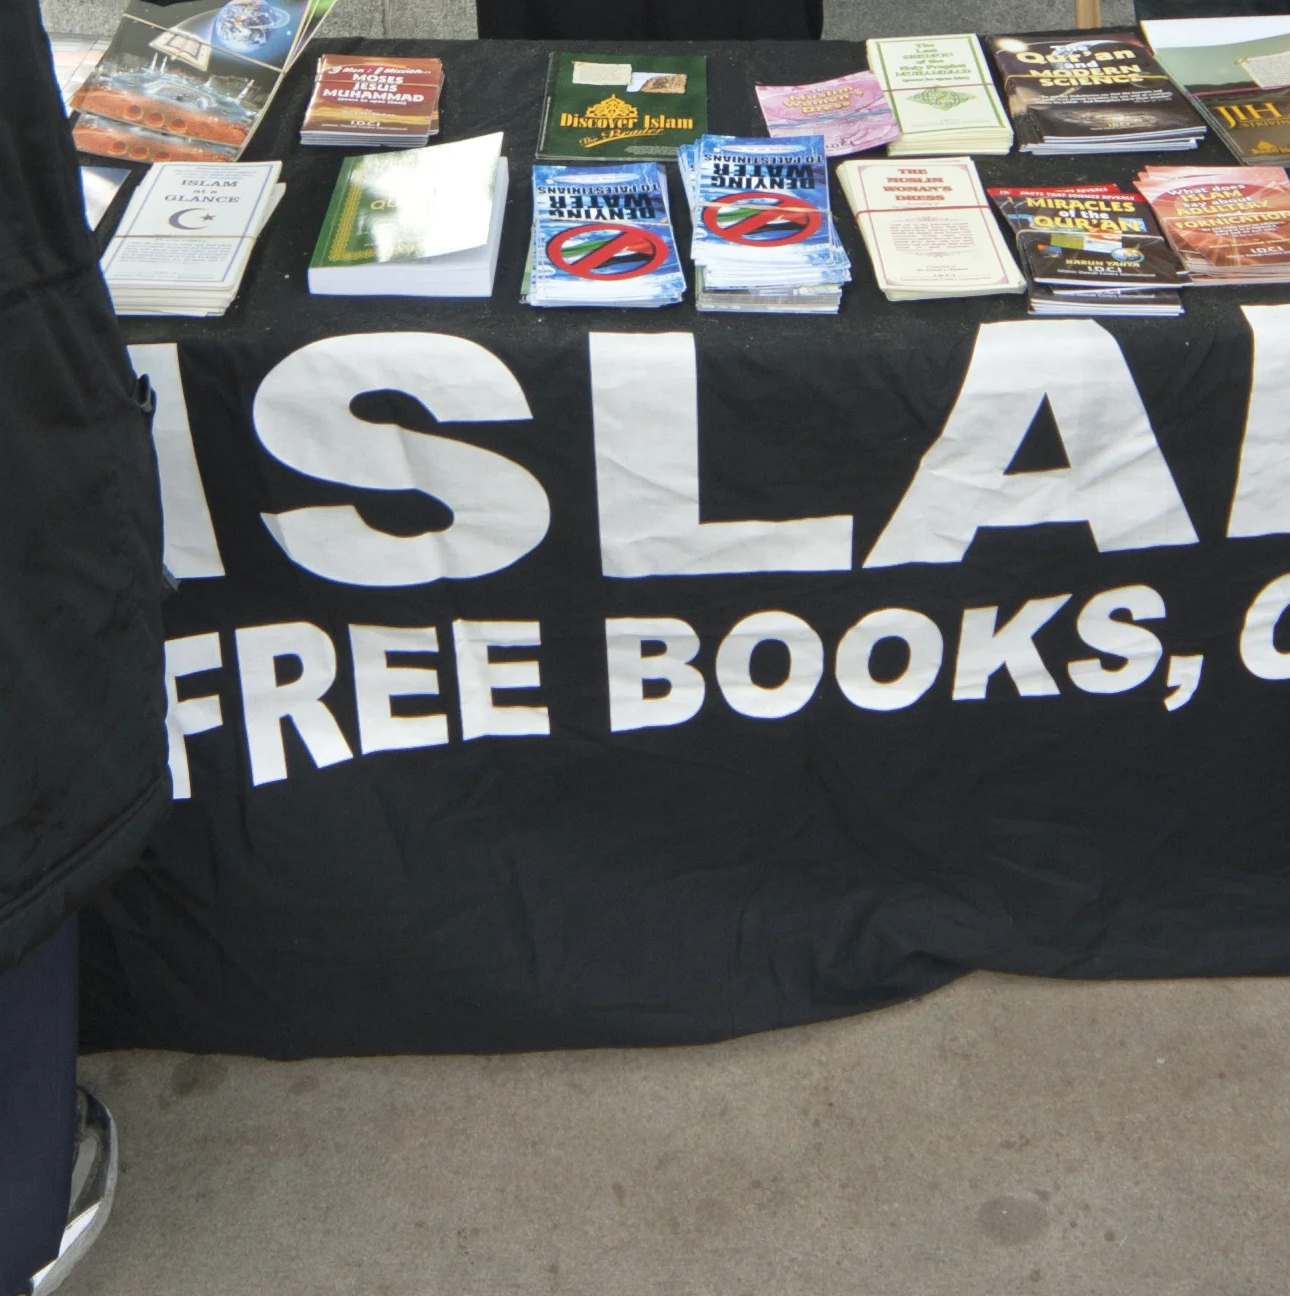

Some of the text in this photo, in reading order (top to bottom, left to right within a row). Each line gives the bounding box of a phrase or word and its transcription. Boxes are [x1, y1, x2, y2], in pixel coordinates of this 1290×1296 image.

[1016, 49, 1136, 64] Qur'an
[328, 64, 342, 74] 3
[1029, 64, 1142, 77] MODERN
[1063, 59, 1099, 69] and
[352, 73, 404, 84] MOSES
[1039, 74, 1145, 87] SCIENCE
[352, 82, 398, 92] JESUS
[323, 89, 425, 103] MUHAMMAD
[800, 100, 851, 114] Dress
[560, 112, 694, 130] Discover Islam
[703, 153, 826, 164] TO PALESTINIANS
[713, 163, 815, 178] WATER
[181, 179, 239, 187] ISLAM
[710, 175, 815, 190] DENYING
[538, 184, 661, 195] TO PALESTINIANS
[1168, 184, 1246, 196] What does
[164, 195, 241, 203] GLANCE
[548, 193, 649, 210] WATER
[1026, 197, 1136, 213] MIRACLES
[1212, 196, 1255, 206] about
[549, 207, 656, 220] DENYING
[1058, 210, 1110, 219] of the
[1176, 200, 1270, 217] ADULTERY
[1034, 215, 1142, 232] QUR'AN
[165, 619, 551, 800] FREE
[605, 585, 1204, 733] BOOKS,
